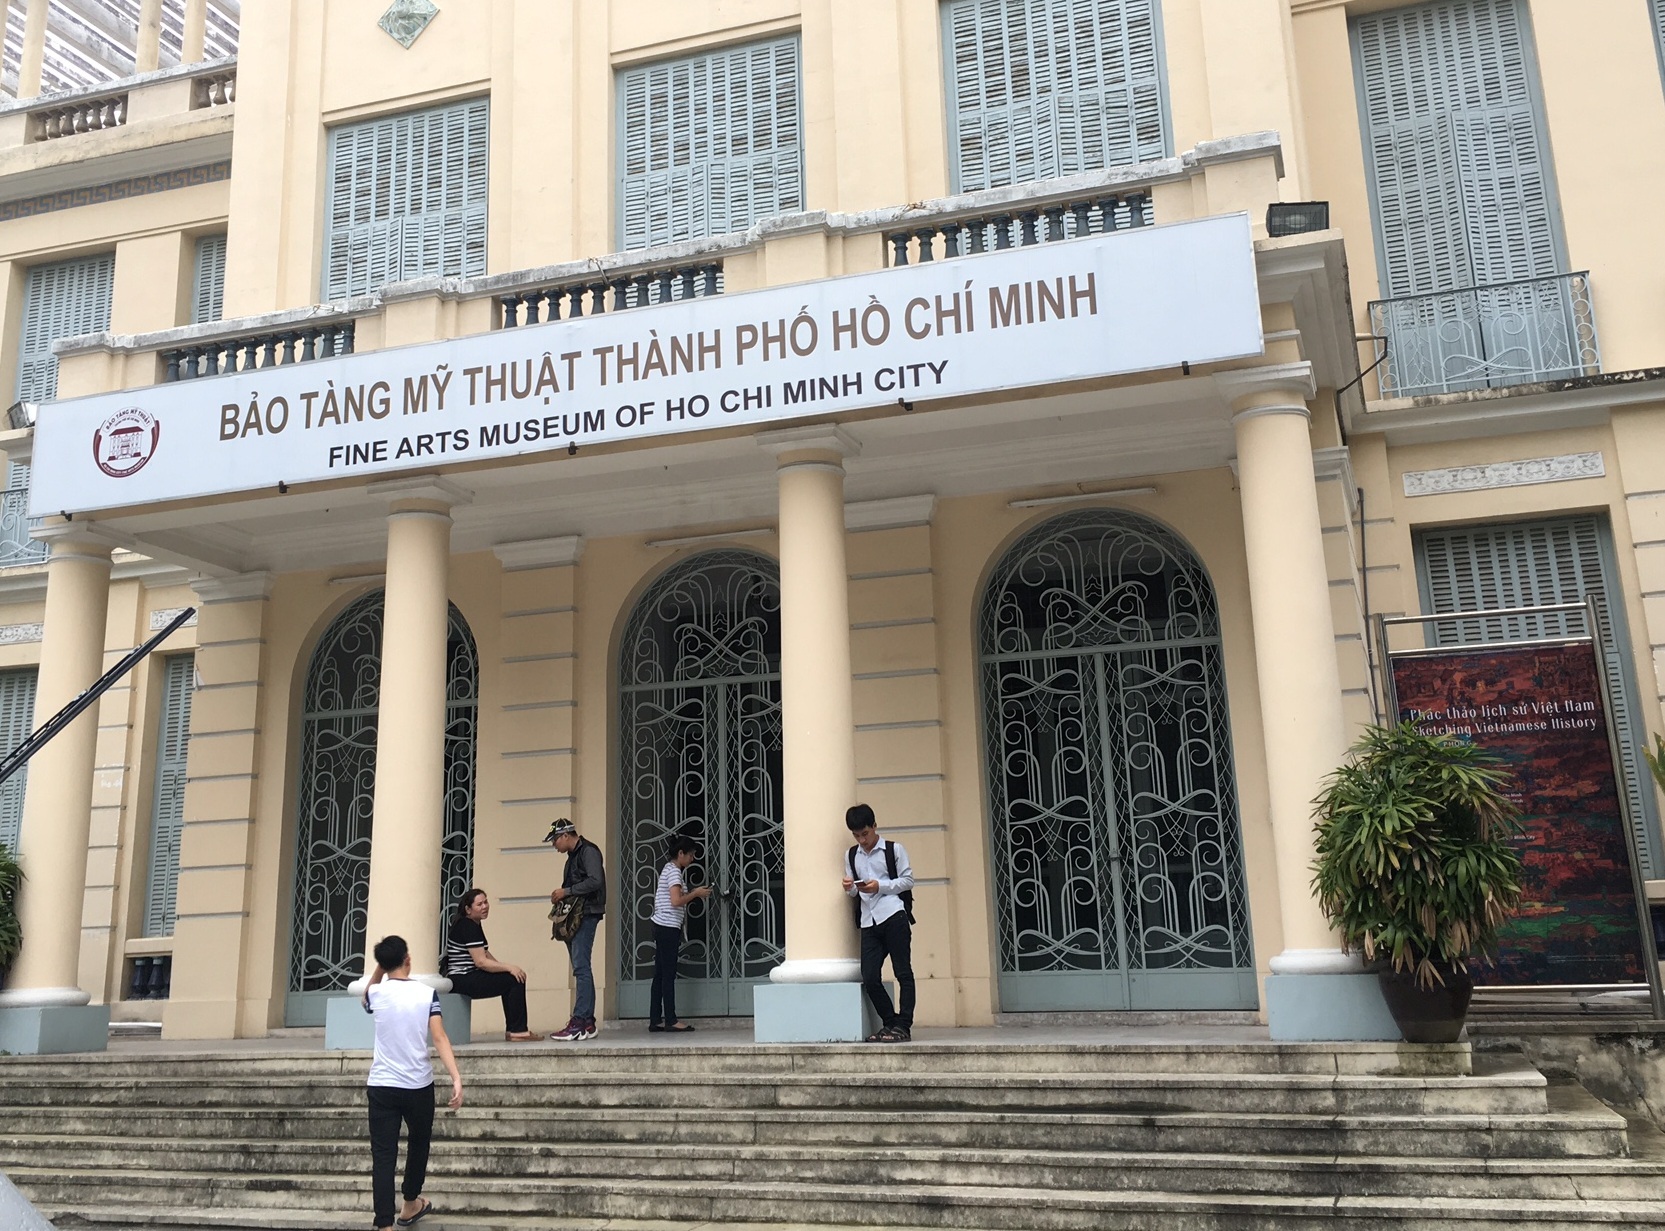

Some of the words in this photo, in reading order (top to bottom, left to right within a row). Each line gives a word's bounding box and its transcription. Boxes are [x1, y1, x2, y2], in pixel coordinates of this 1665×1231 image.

[219, 390, 289, 441] BẢO
[299, 379, 391, 429] TÀNG
[402, 363, 454, 416] MỸ
[462, 351, 582, 406] THUẬT
[592, 329, 722, 386] THÀNH
[735, 304, 819, 366] PHỐ
[832, 294, 891, 352] HỒ
[904, 279, 975, 340] CHÍ
[988, 272, 1098, 329] MINH
[328, 436, 389, 468] FINE
[394, 428, 470, 460] ARTS
[479, 408, 605, 448] MUSEUM
[615, 401, 656, 428] OF
[666, 394, 710, 422] HO
[719, 384, 772, 414] CHI
[783, 371, 863, 406] MINH
[874, 359, 949, 392] CITY
[1412, 723, 1472, 738] Sketching
[1475, 721, 1547, 734] Vietnamese
[1551, 717, 1597, 731] History
[1446, 705, 1477, 720] thảo
[1481, 704, 1507, 720] lịch
[1531, 701, 1560, 717] Việt
[1565, 700, 1595, 713] Nam
